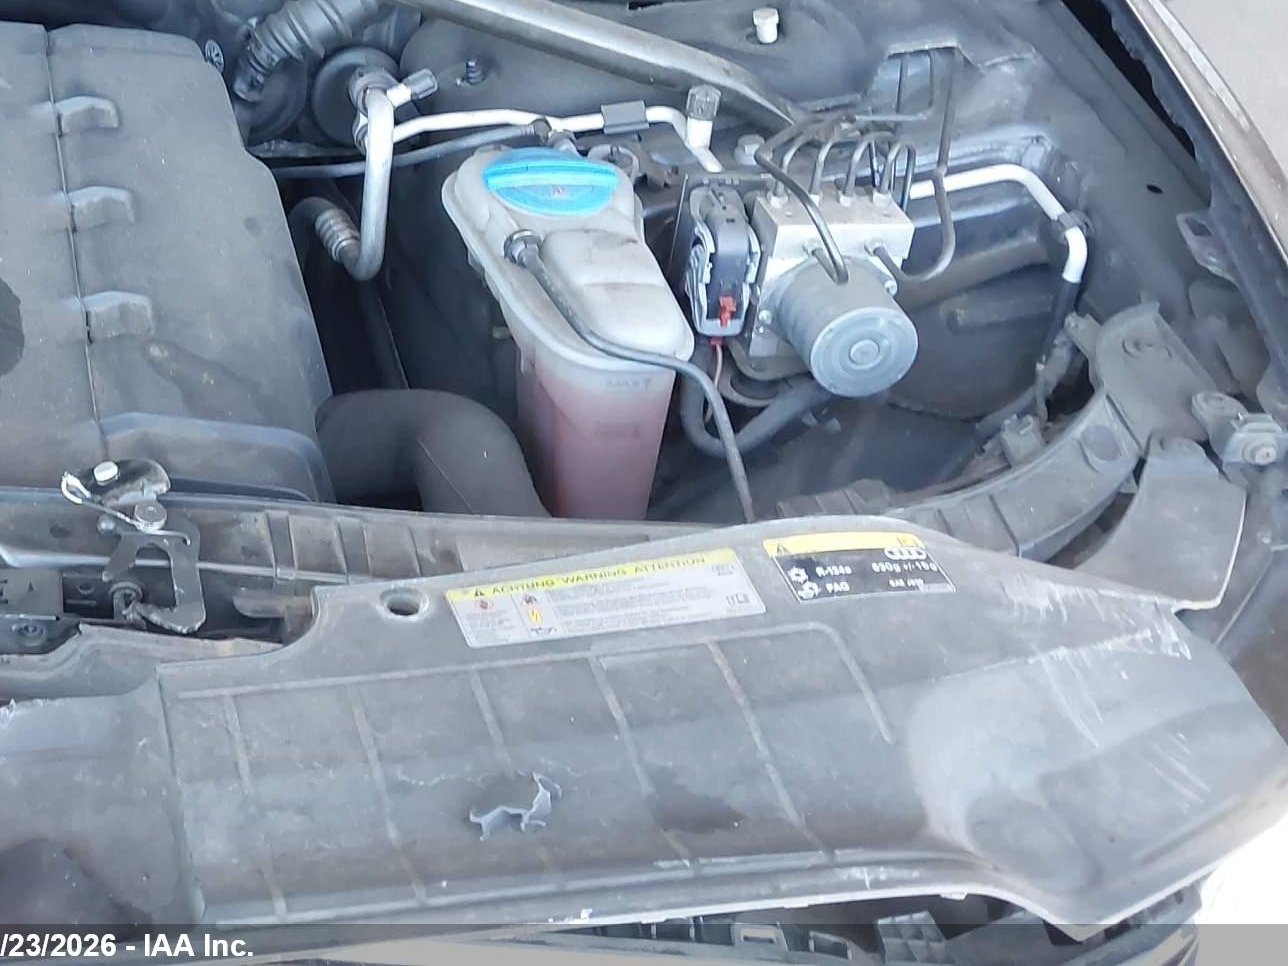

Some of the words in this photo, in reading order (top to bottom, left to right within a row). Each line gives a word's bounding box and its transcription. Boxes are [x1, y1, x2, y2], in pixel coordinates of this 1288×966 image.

[491, 578, 555, 594] ACHTUNG
[562, 568, 627, 585] WARNING
[633, 555, 706, 574] ATTENTION
